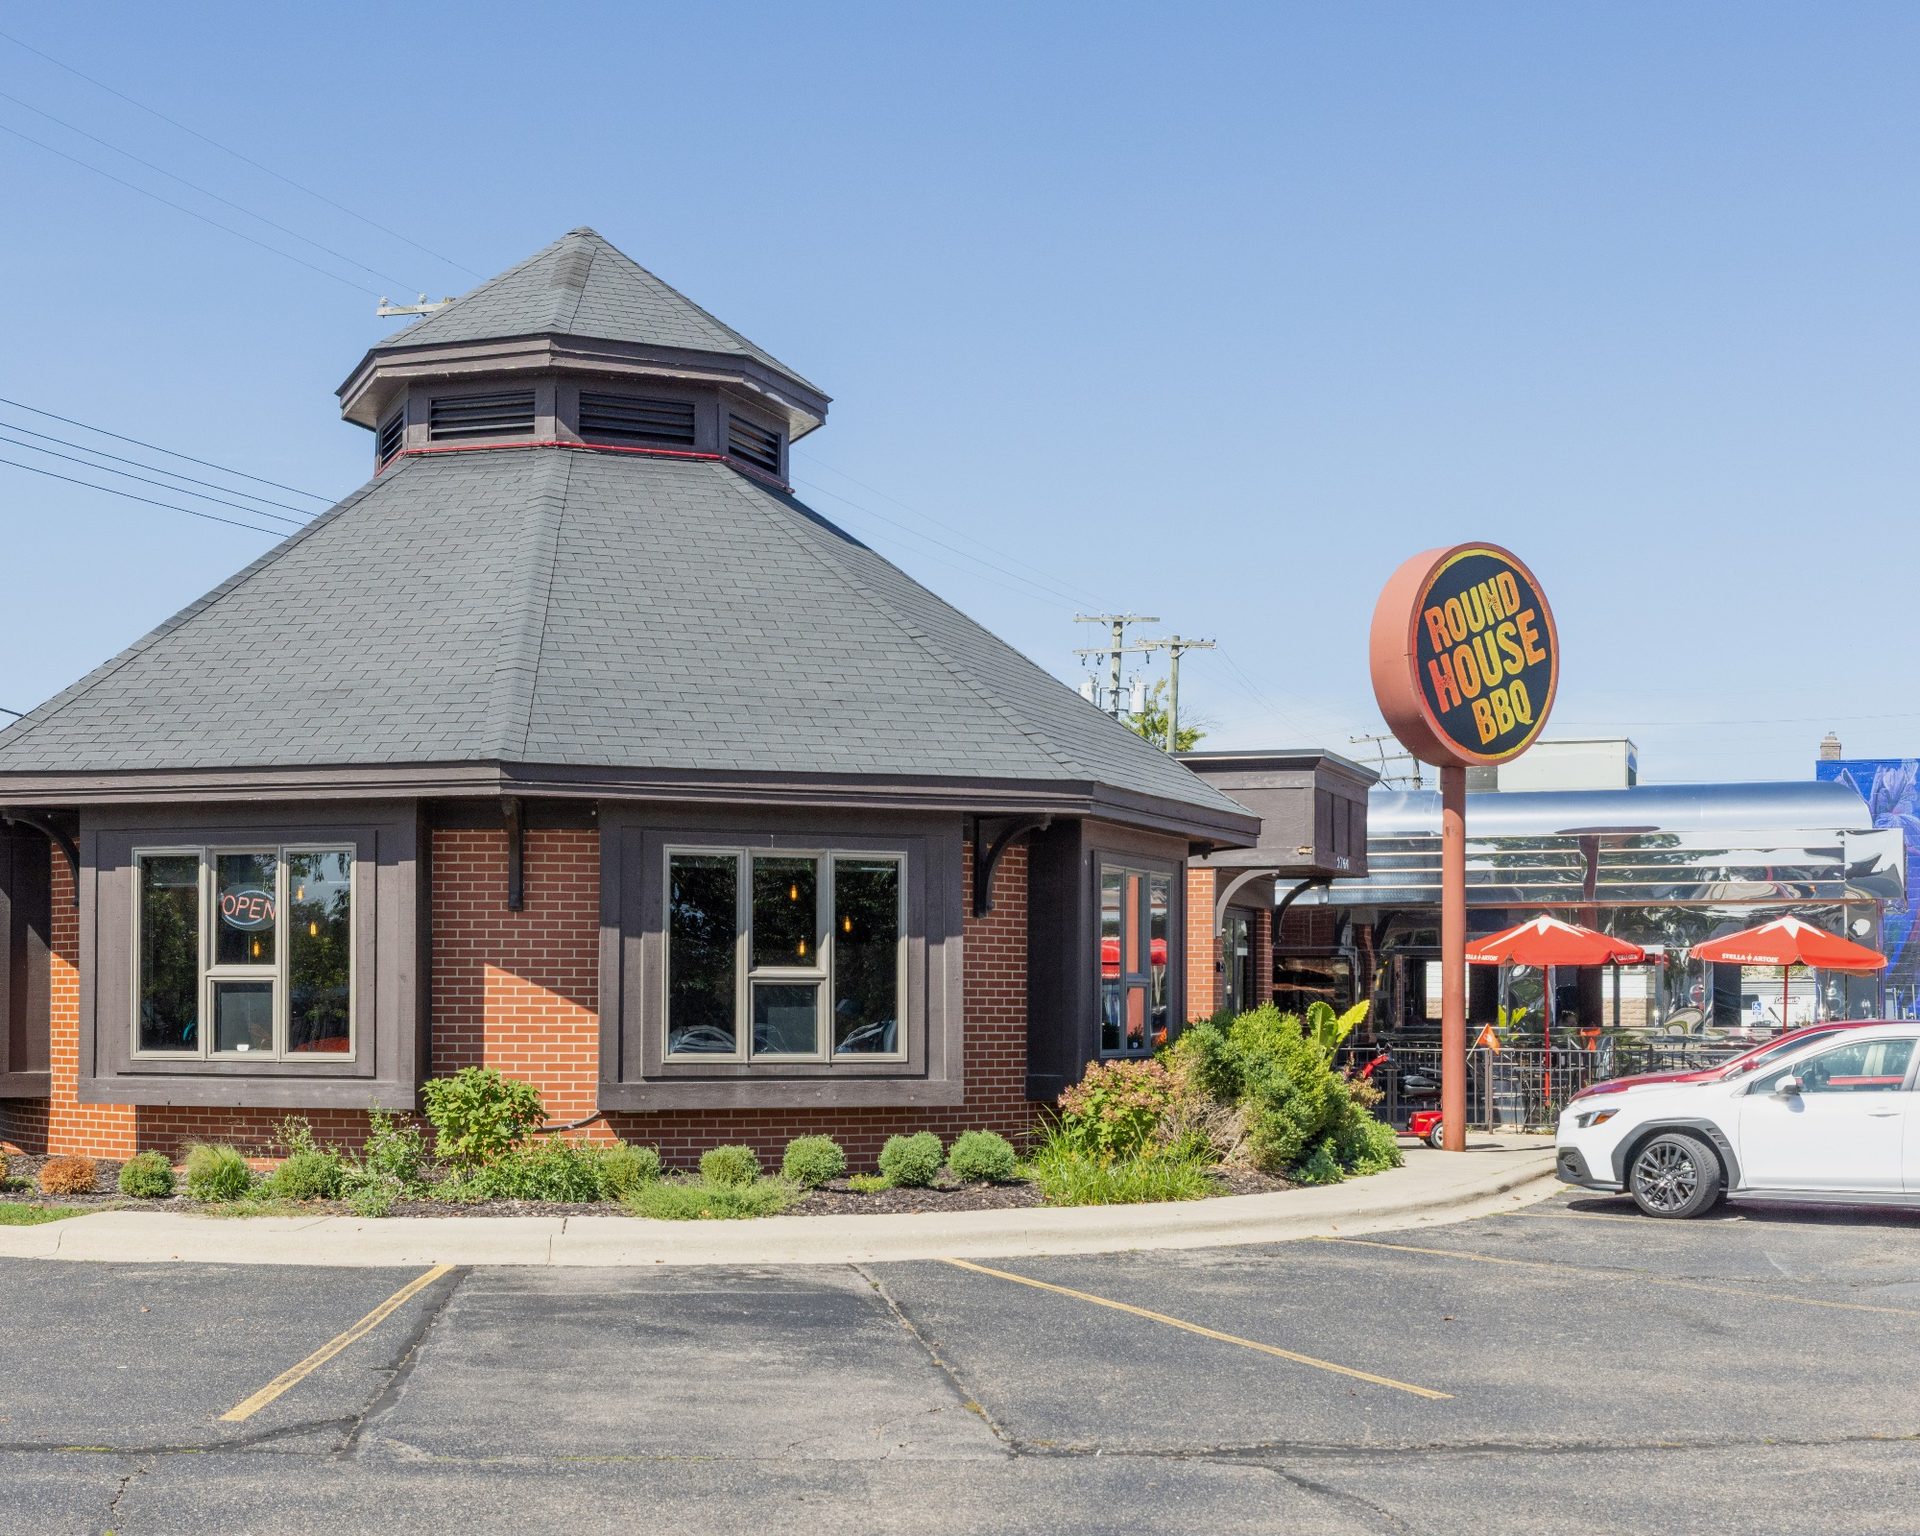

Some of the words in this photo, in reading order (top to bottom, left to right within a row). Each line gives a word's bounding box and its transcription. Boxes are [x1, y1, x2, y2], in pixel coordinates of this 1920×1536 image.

[1424, 570, 1520, 653] ROUND
[1428, 608, 1546, 714] HOUSE
[1471, 679, 1533, 744] BBQ
[222, 895, 276, 920] OPEN
